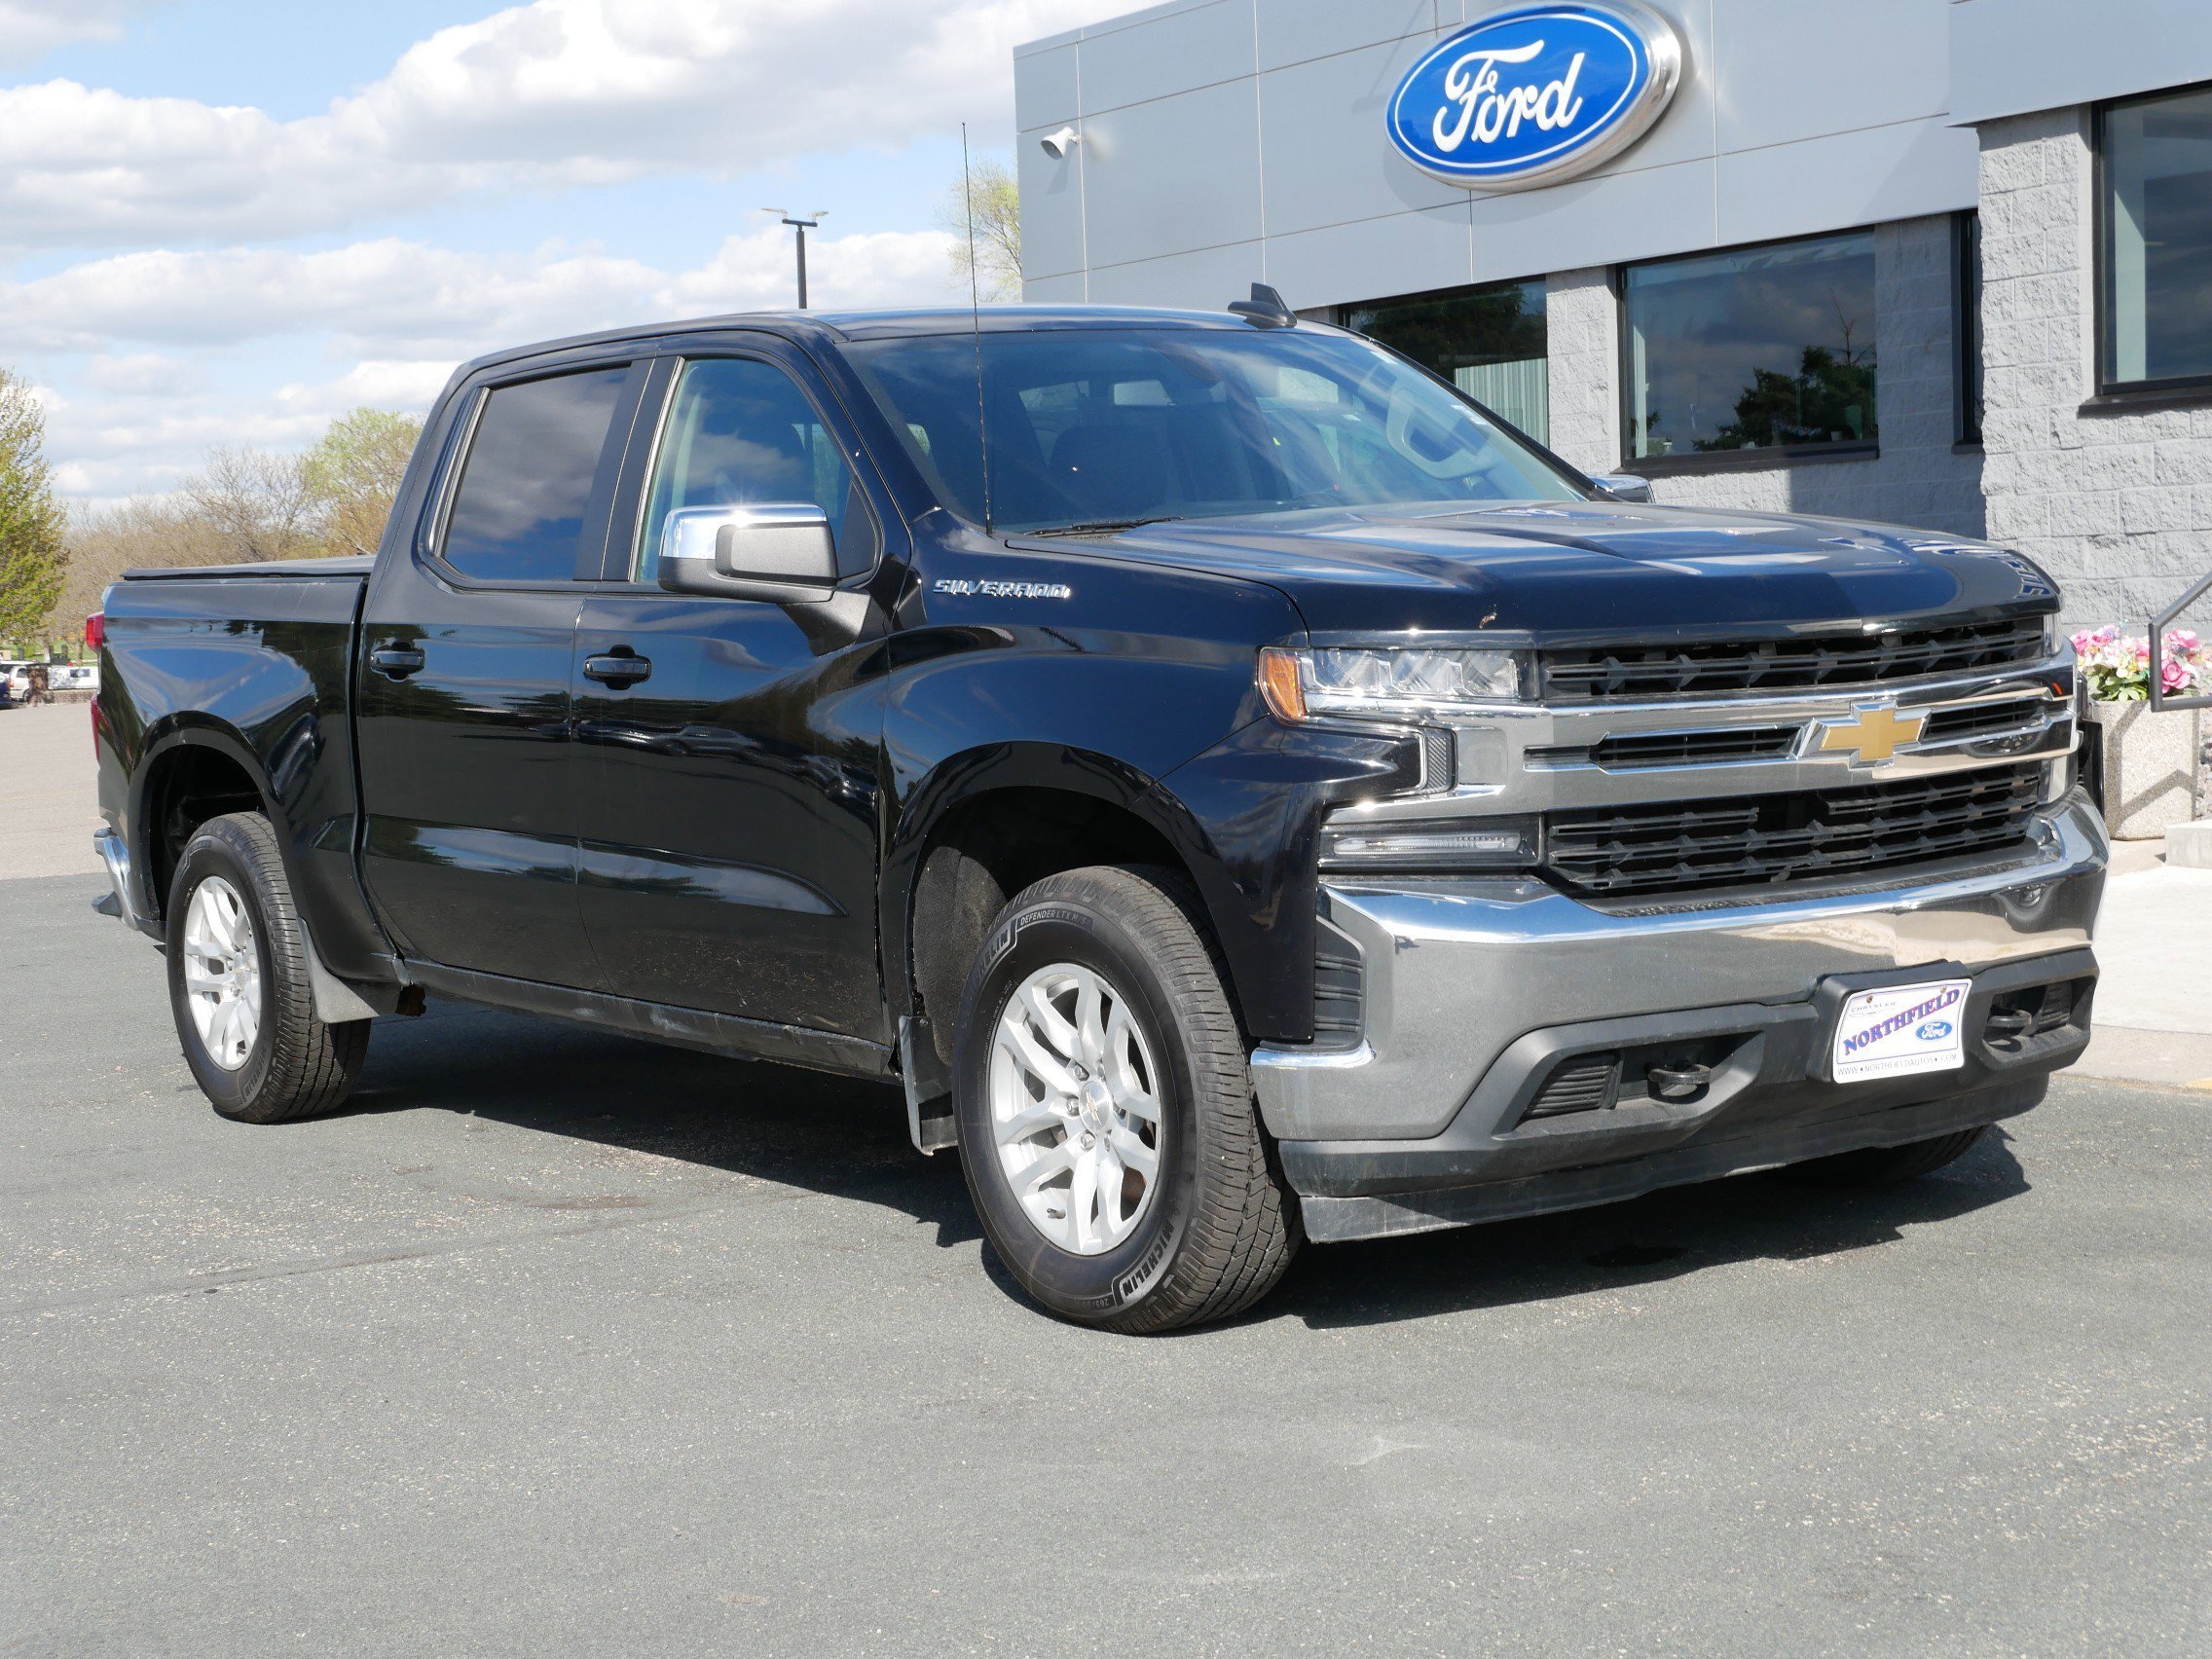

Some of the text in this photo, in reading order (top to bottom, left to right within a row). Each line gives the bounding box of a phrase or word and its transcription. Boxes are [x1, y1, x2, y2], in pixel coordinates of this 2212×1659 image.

[1432, 39, 1585, 153] Ford
[933, 579, 1072, 599] SILVERADO
[1020, 909, 1055, 926] DEFENDER
[1843, 988, 1960, 1055] NORTHFIELD
[1922, 1021, 1946, 1039] Ford
[1122, 1221, 1175, 1297] MICHELIN
